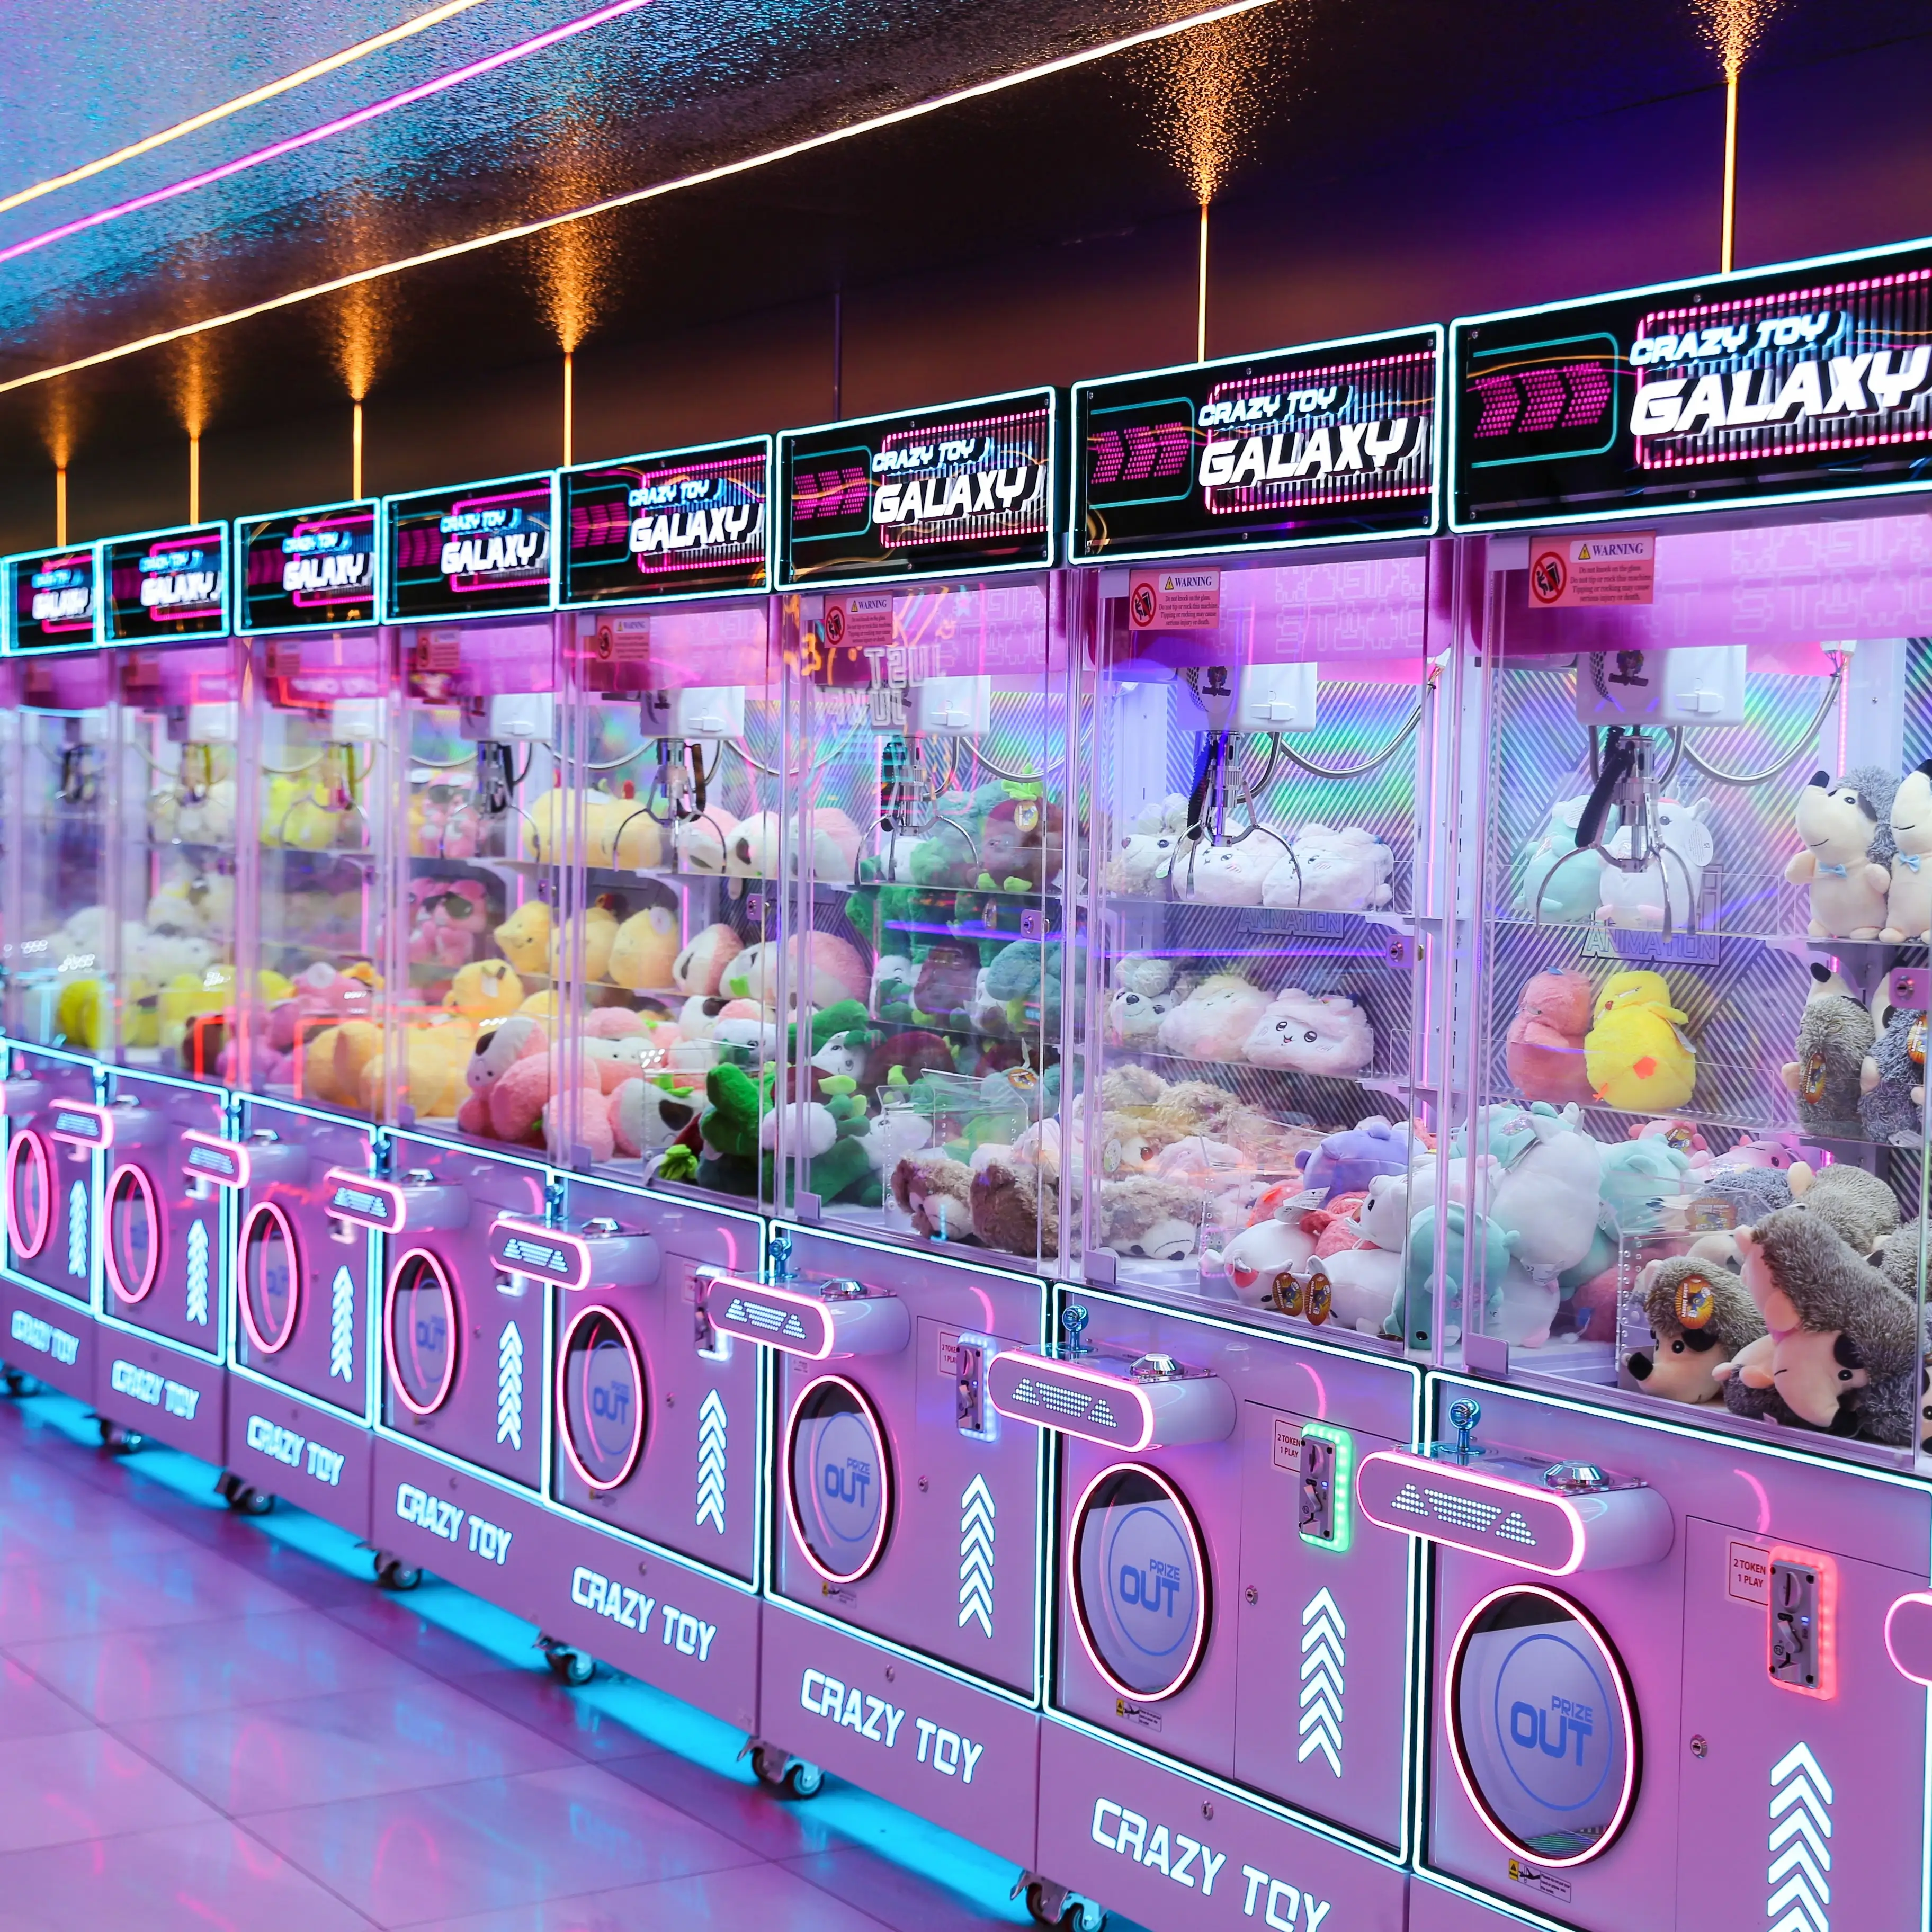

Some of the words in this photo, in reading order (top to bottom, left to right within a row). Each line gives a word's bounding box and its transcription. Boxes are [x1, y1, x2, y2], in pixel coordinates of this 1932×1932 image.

[1630, 325, 1748, 366] CRAZY
[1757, 311, 1830, 347] TOY
[1198, 395, 1280, 426] CRAZY
[1287, 386, 1338, 413] TOY
[1630, 347, 1932, 436] GALAXY
[872, 444, 934, 472] CRAZY
[938, 439, 976, 462] TOY
[1198, 418, 1408, 487] GALAXY
[629, 483, 677, 507] CRAZY
[678, 479, 711, 501] TOY
[872, 466, 1026, 524] GALAXY
[441, 512, 480, 533] CRAZY
[481, 508, 506, 527] TOY
[630, 505, 750, 553] GALAXY
[441, 532, 537, 574] GALAXY
[1593, 543, 1643, 556] WARNING
[141, 571, 214, 606] GALAXY
[283, 553, 364, 591] GALAXY
[1175, 576, 1212, 587] WARNING
[858, 600, 887, 609] WARNING
[1245, 908, 1340, 933] ANIMATION
[1587, 928, 1716, 960] ANIMATION
[417, 1322, 445, 1353] OUT
[594, 1386, 629, 1425] OUT
[246, 1415, 306, 1468] CRAZY
[306, 1441, 345, 1487] TOY
[1282, 1435, 1301, 1447] TOKEN
[1284, 1447, 1298, 1458] PLAY
[847, 1457, 870, 1475] PRIZE
[825, 1464, 870, 1508] OUT
[396, 1482, 464, 1542] CRAZY
[468, 1515, 513, 1565] TOY
[1150, 1559, 1180, 1581] PRIZE
[1734, 1559, 1738, 1568] 2
[1740, 1560, 1767, 1575] TOKEN
[1744, 1575, 1764, 1588] PLAY
[1120, 1564, 1180, 1618] OUT
[571, 1566, 656, 1633] CRAZY
[661, 1604, 717, 1661] TOY
[800, 1668, 905, 1748] CRAZY
[916, 1717, 983, 1784] TOY
[1552, 1695, 1593, 1724] PRIZE
[1511, 1701, 1593, 1767] OUT
[1091, 1797, 1226, 1896] CRAZY
[1242, 1864, 1330, 1932] TOY
